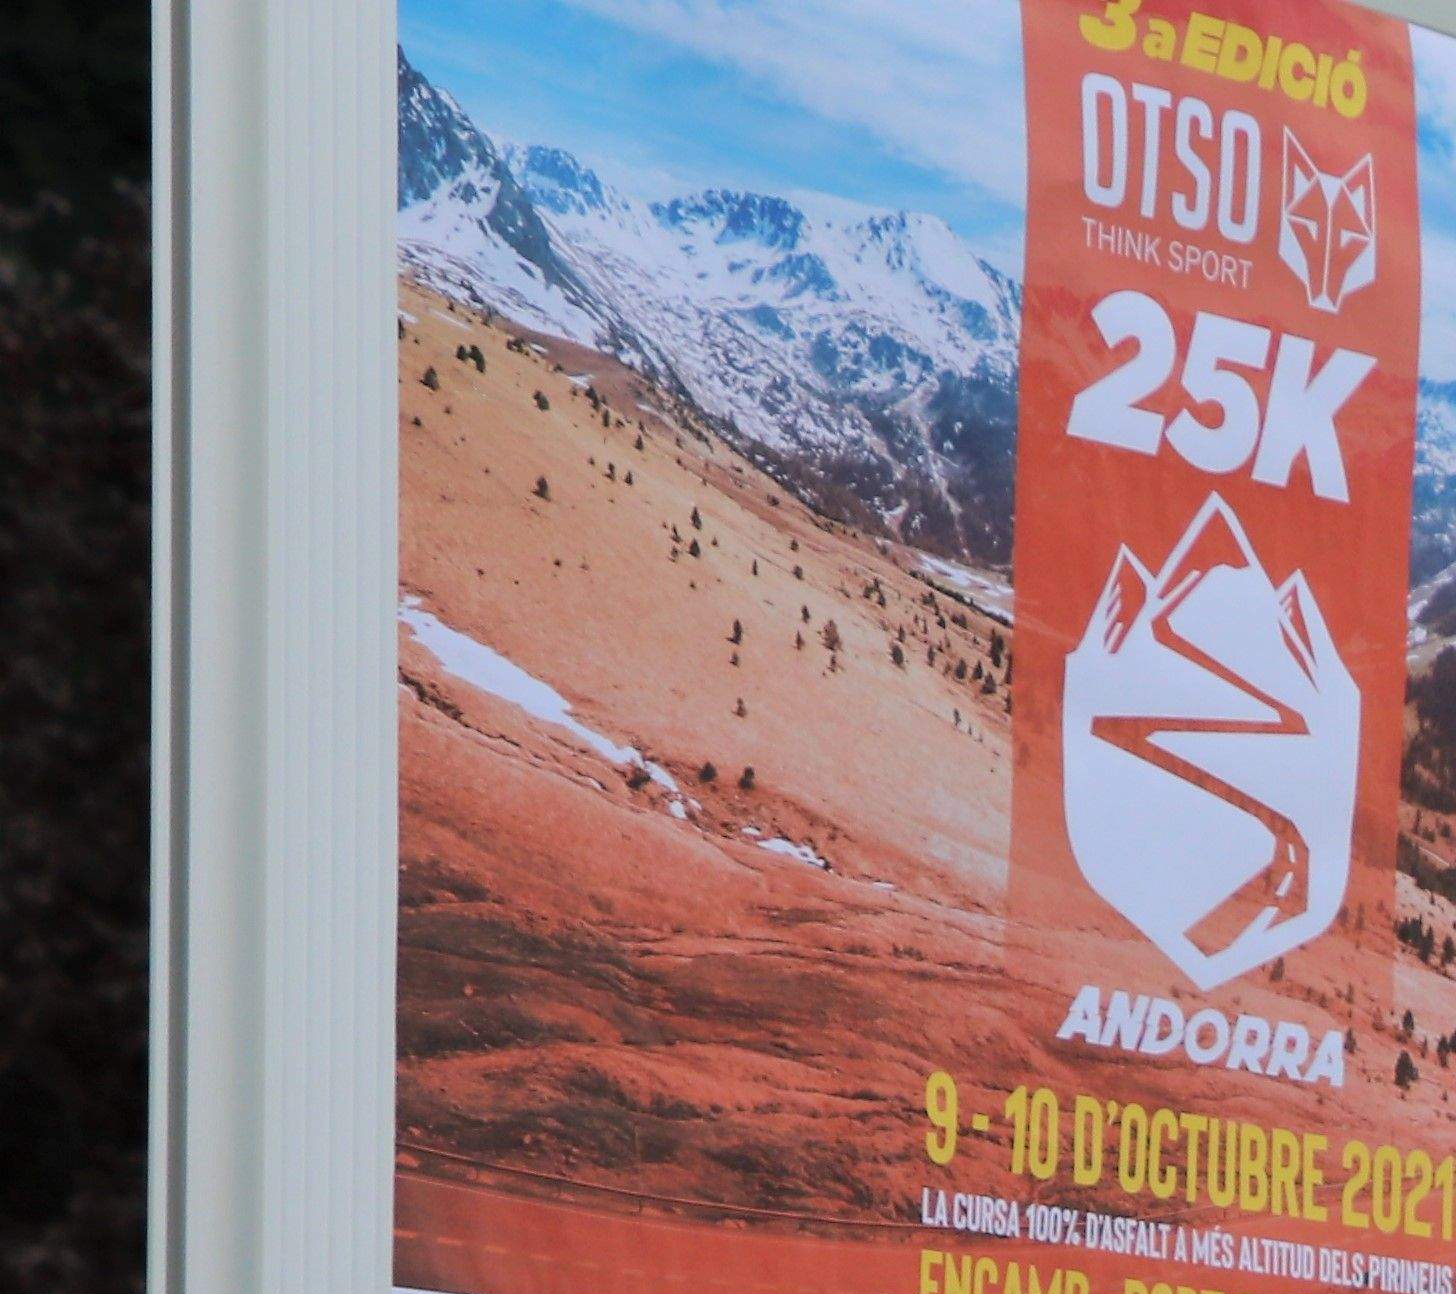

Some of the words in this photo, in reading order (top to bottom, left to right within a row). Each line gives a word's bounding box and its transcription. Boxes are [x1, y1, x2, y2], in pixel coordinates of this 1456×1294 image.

[1180, 11, 1368, 118] EDICIÓ
[1081, 72, 1261, 243] OTSO
[1082, 216, 1161, 267] THINK
[1169, 241, 1253, 288] SPORT
[1067, 290, 1377, 502] 25K
[1057, 985, 1344, 1088] ANDORRA
[925, 1071, 958, 1165] 9
[1003, 1085, 1059, 1180] 10
[1074, 1098, 1327, 1222] D'OCTUBRE
[1342, 1140, 1454, 1241] 2021
[921, 1186, 948, 1228] LA
[953, 1192, 1020, 1238] CURSA
[1026, 1203, 1080, 1246] 100%
[1085, 1212, 1170, 1260] D'ASFALT
[1174, 1226, 1187, 1263] A
[1192, 1225, 1234, 1269] MÉS
[1239, 1236, 1314, 1280] ALTITUD
[1319, 1247, 1365, 1288] DELS
